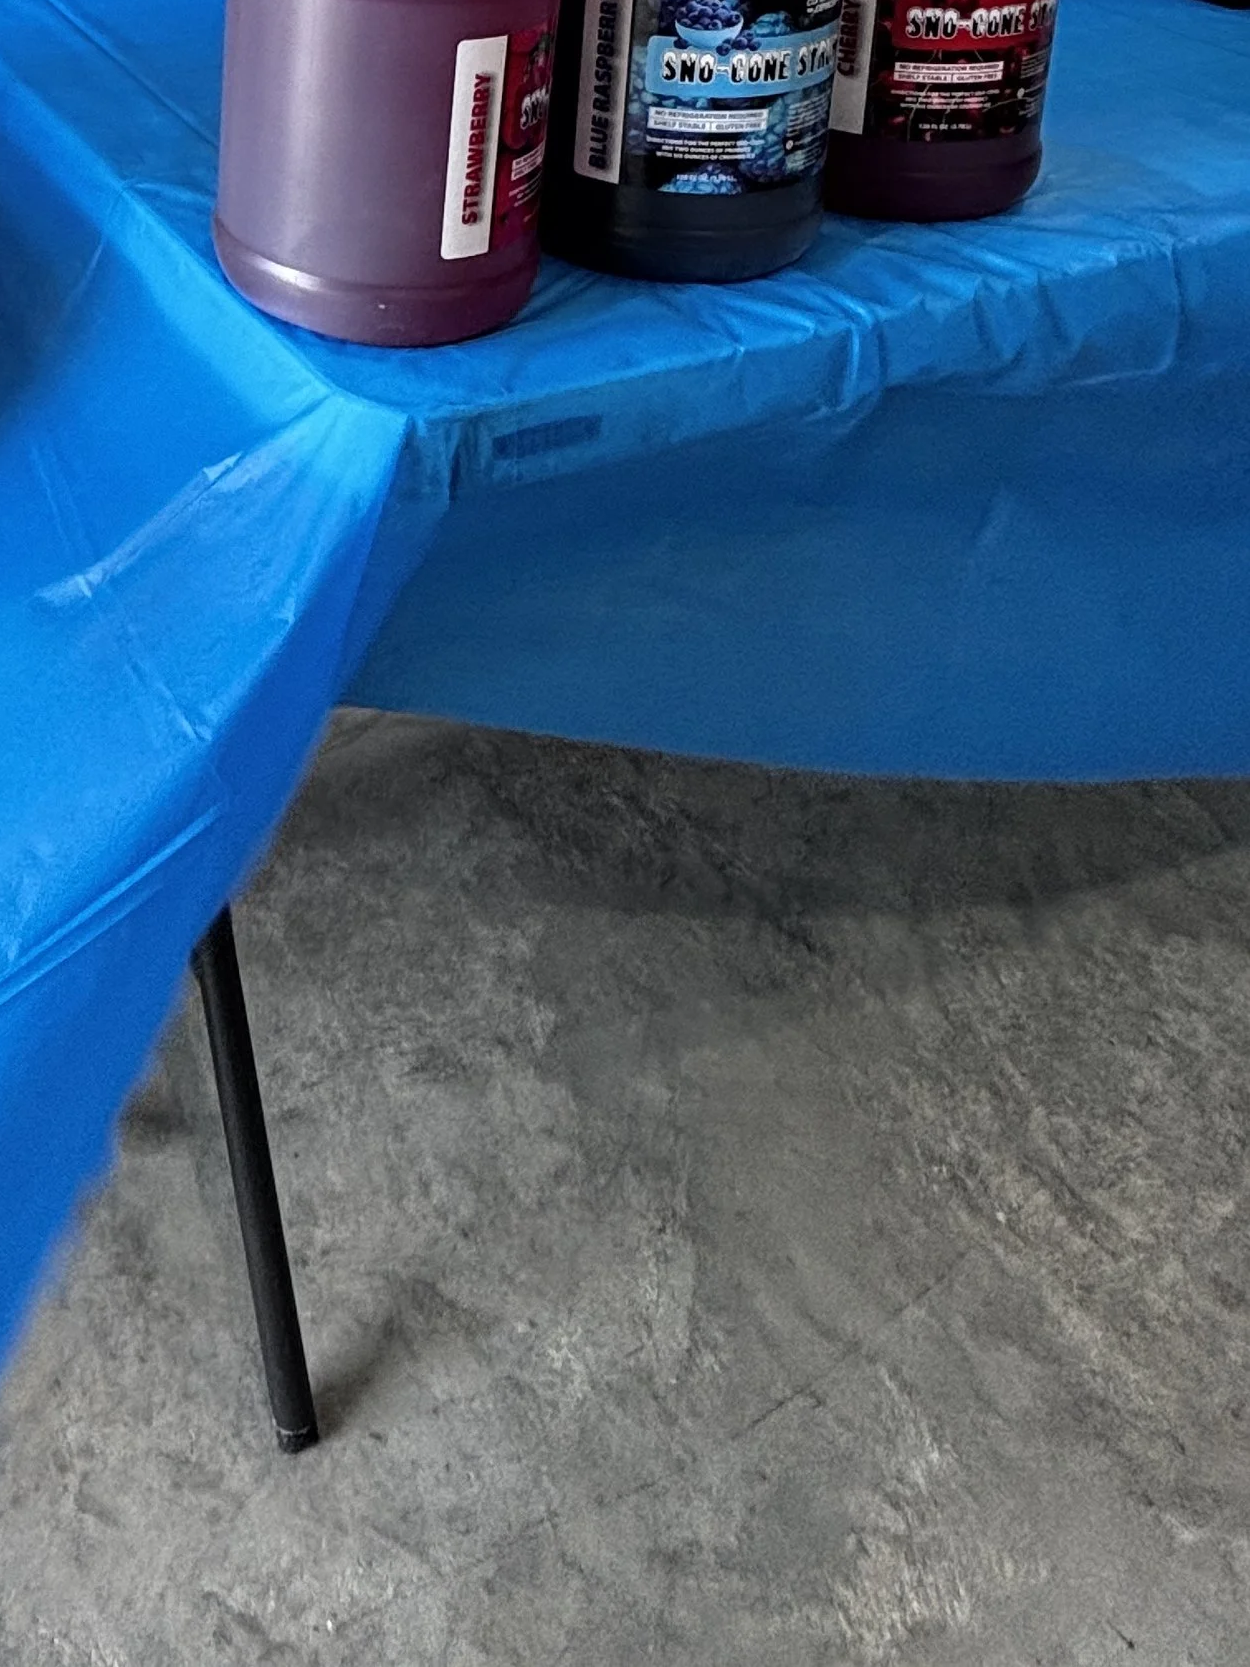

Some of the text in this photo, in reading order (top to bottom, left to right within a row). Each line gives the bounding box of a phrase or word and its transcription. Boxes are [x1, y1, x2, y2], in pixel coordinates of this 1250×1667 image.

[906, 5, 1027, 40] SNO-CONE
[662, 49, 792, 85] SNO-CONE
[461, 73, 491, 226] STRAWBERRY
[588, 114, 609, 170] BLUE
